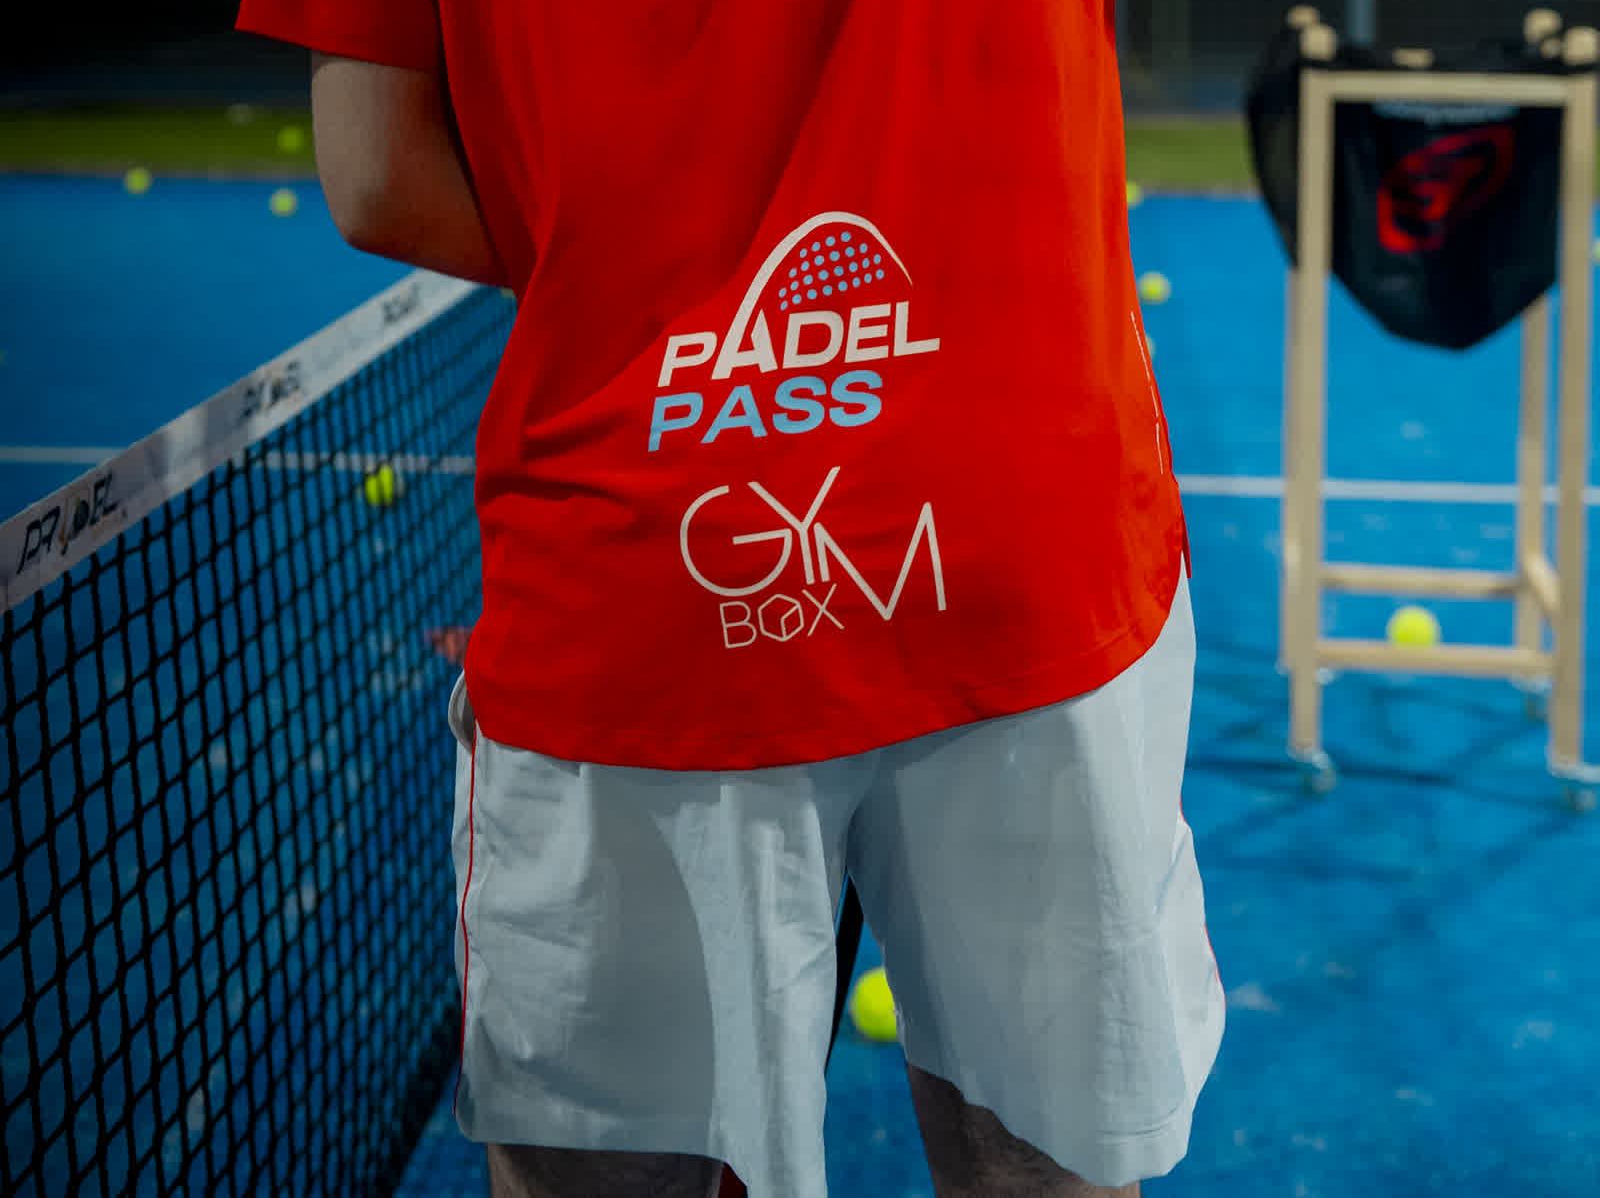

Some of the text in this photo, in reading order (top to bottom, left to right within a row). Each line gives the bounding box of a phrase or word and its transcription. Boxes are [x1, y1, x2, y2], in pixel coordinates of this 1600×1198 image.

[657, 292, 940, 387] PADEL
[648, 370, 883, 452] PASS
[680, 466, 946, 620] GYM
[720, 583, 844, 649] BOX
